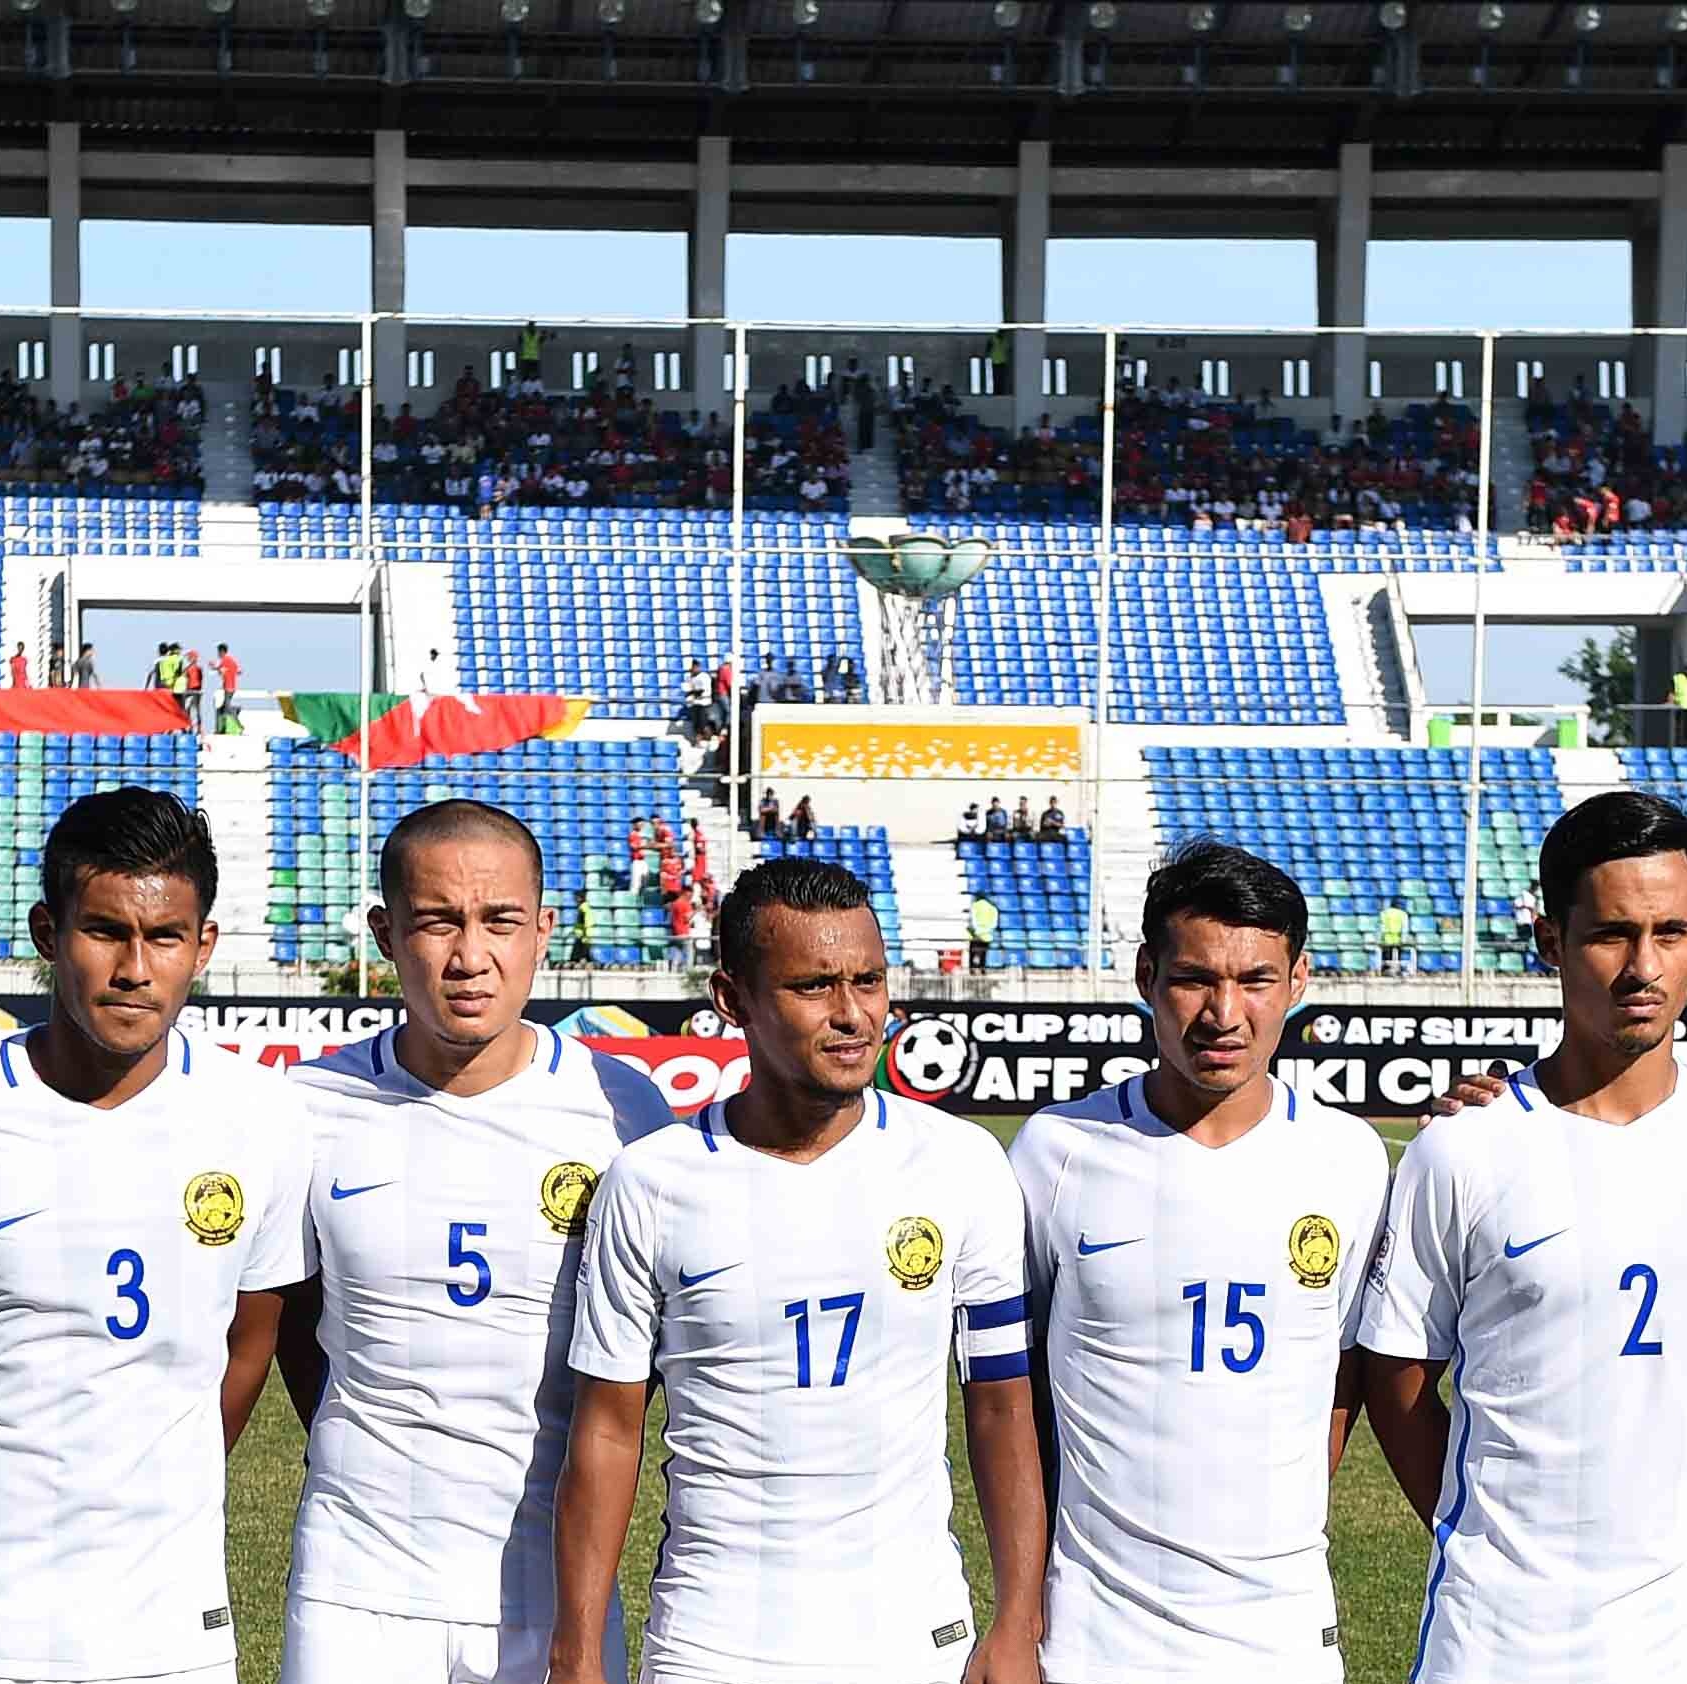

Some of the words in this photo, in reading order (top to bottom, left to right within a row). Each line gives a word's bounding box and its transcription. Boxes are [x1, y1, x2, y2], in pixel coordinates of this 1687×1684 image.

[972, 1013, 1063, 1042] CUP
[1068, 1014, 1143, 1043] 2016
[1344, 1017, 1416, 1045] AFF
[972, 1057, 1088, 1101] AFF
[105, 1247, 151, 1340] 3
[448, 1222, 492, 1308] 5
[783, 1291, 865, 1388] 17
[1182, 1281, 1267, 1374] 15
[1619, 1263, 1663, 1357] 2
